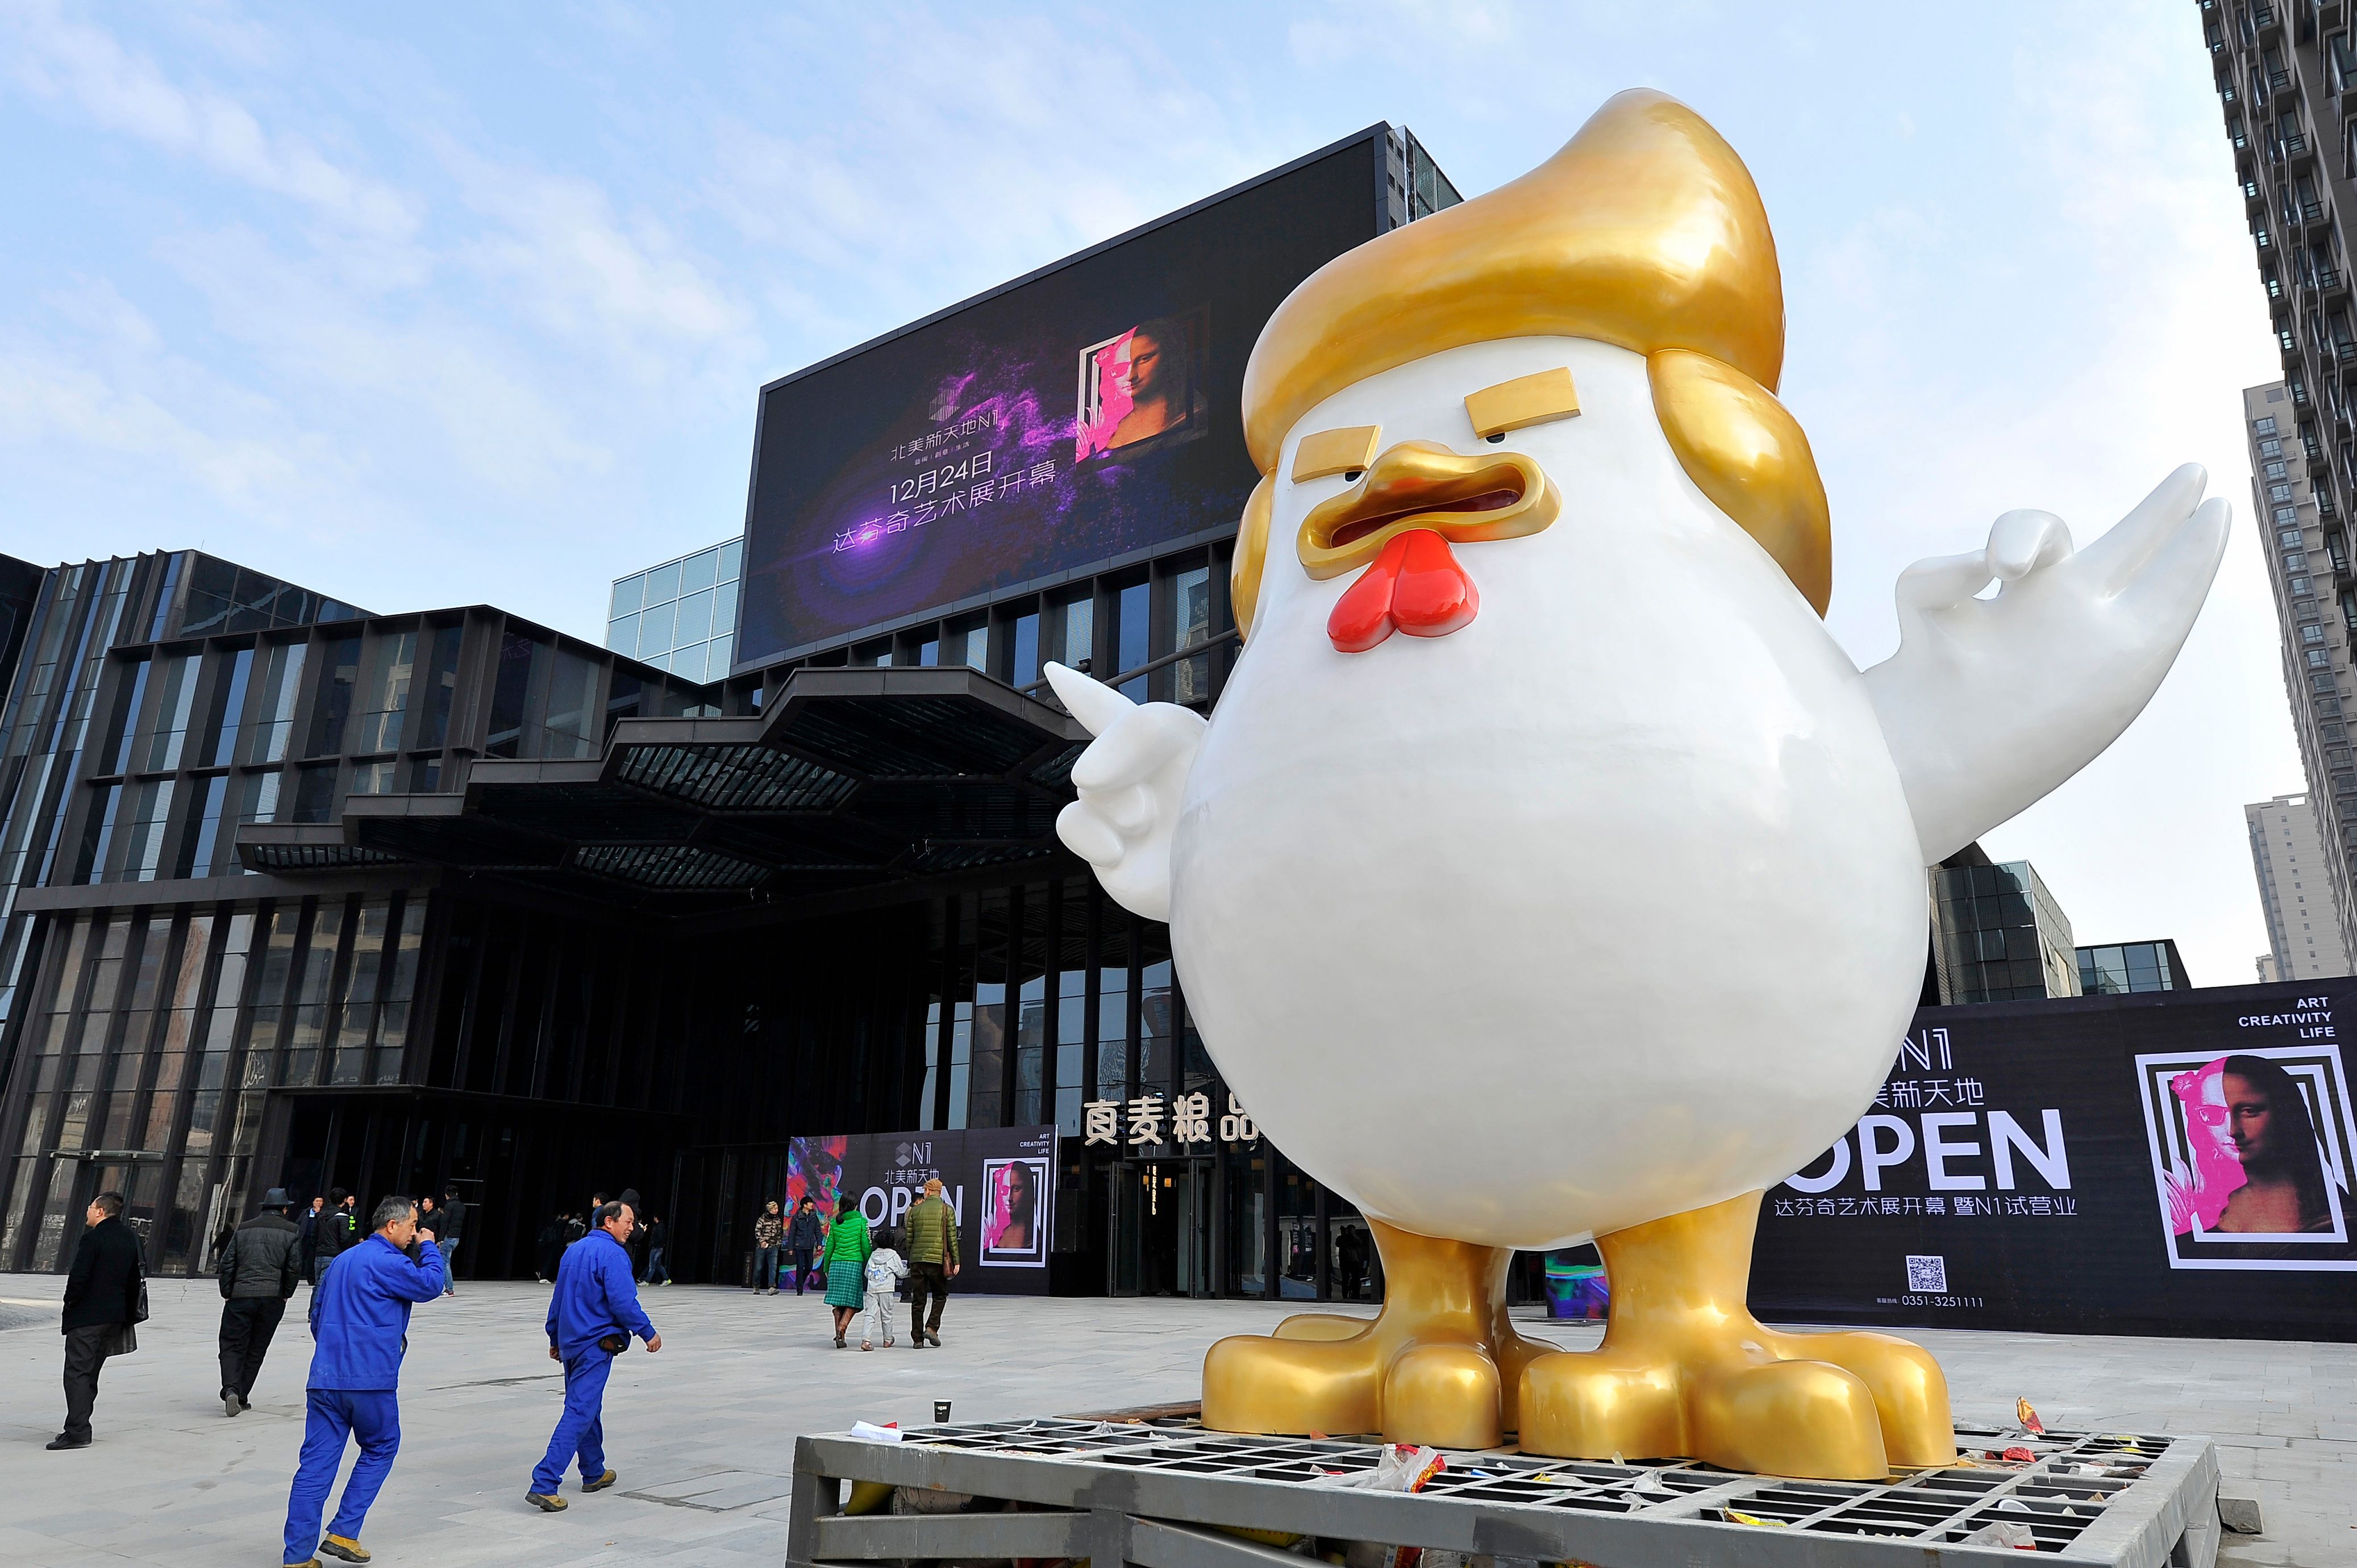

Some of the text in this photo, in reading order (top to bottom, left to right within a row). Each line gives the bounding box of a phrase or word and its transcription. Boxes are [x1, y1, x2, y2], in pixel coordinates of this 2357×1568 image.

[890, 410, 998, 462] 北美新天地N1
[890, 451, 992, 504] 12月24日
[832, 458, 1056, 553] 达芬奇艺术展开幕
[2297, 997, 2328, 1008] ART
[2238, 1012, 2331, 1027] CREATIVITY
[2300, 1027, 2335, 1039] LIFE
[912, 1142, 931, 1165] N1
[884, 1168, 939, 1185] 北美新天地
[1775, 1196, 2078, 1216] 达芬奇艺术展开幕 暨N1试营业
[1901, 1295, 1983, 1308] 0351-3251111
